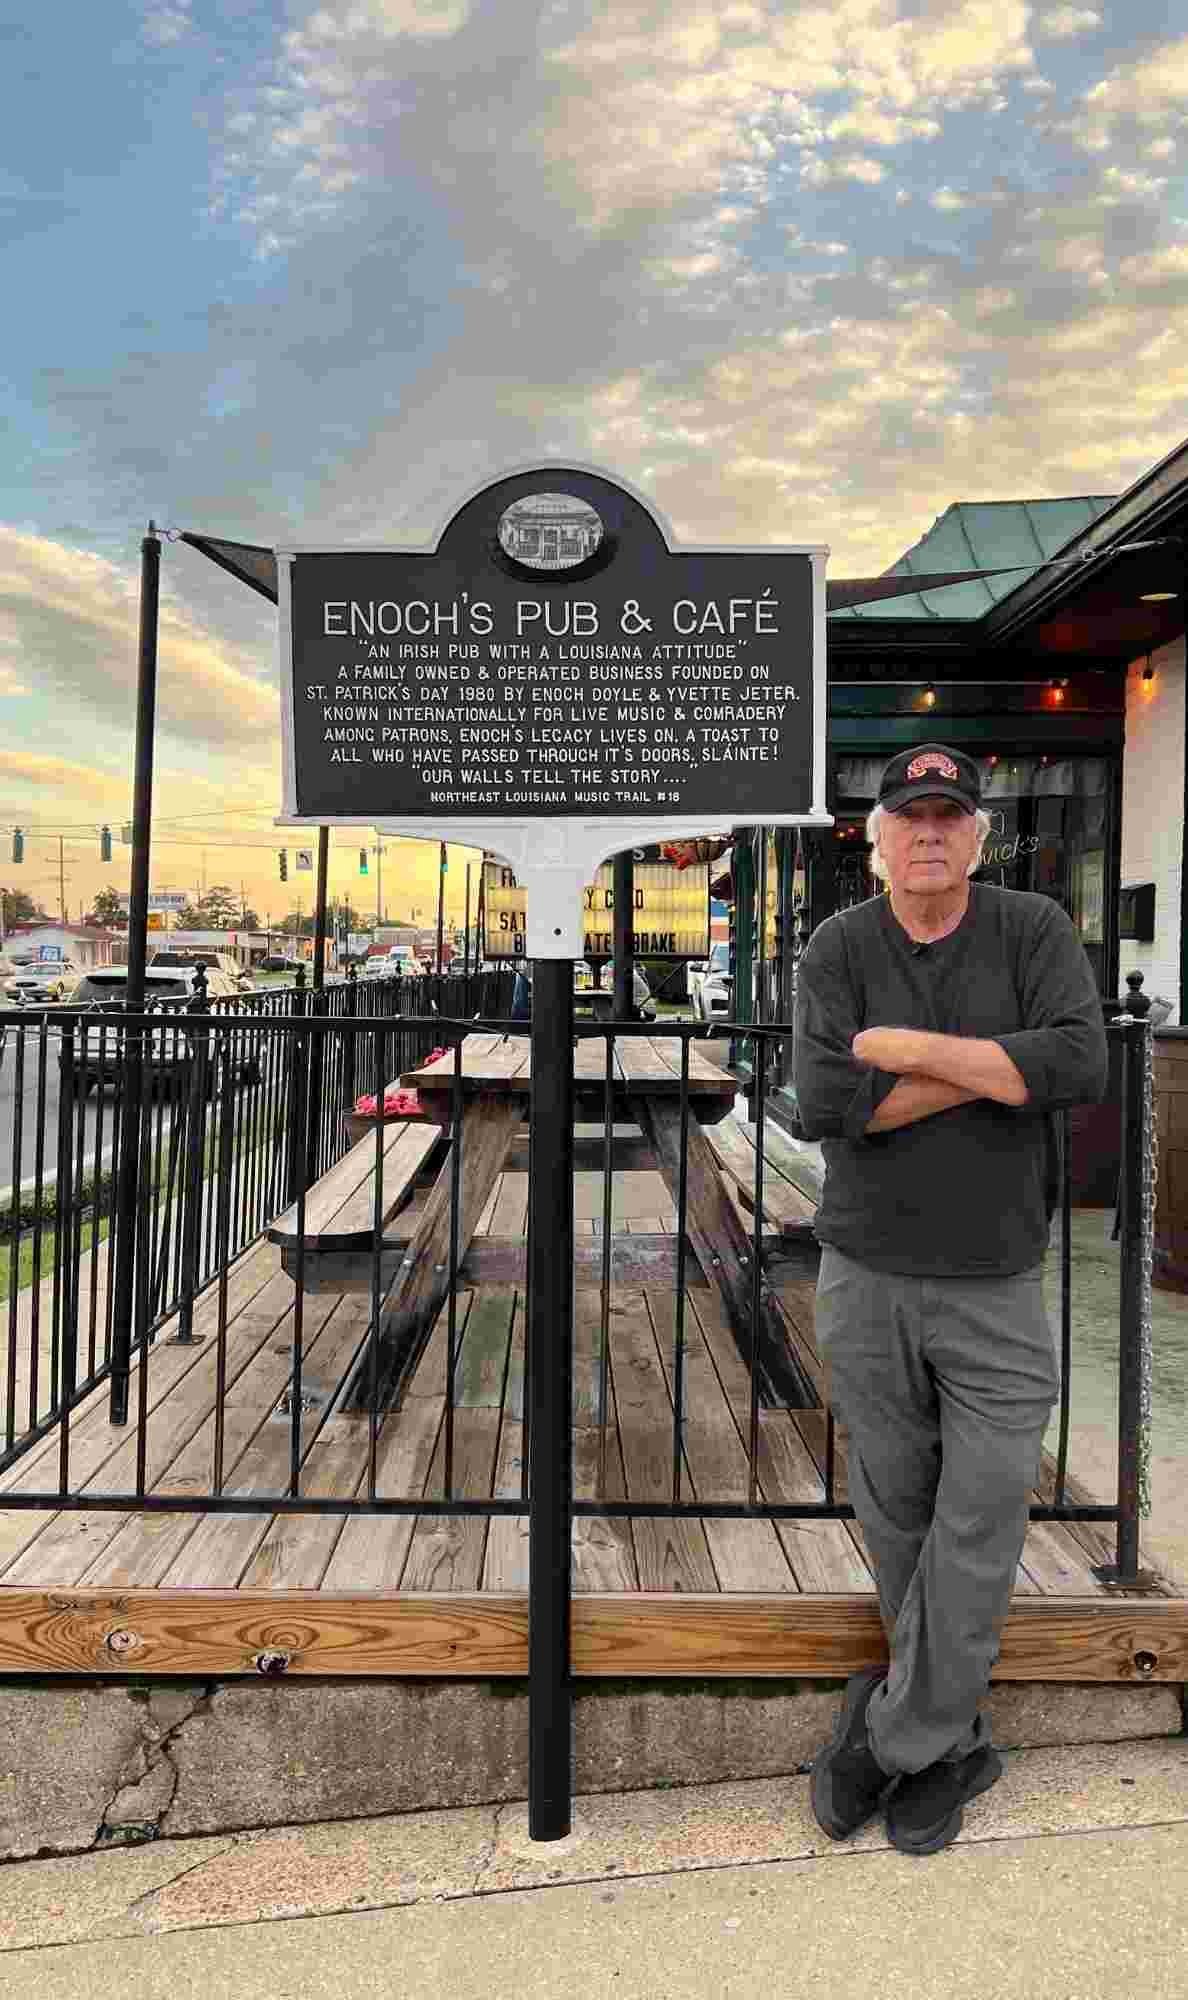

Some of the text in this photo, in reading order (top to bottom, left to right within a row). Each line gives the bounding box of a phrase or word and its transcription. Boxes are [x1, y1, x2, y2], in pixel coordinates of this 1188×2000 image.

[323, 587, 779, 636] ENOCH'S PUB & CAFÉ
[399, 644, 439, 659] IRISH
[448, 644, 480, 659] PUB
[489, 644, 531, 659] WITH
[539, 645, 550, 659] A
[559, 644, 643, 660] LOUISIANA
[337, 664, 769, 681] A FAMILY OWNED & OPERATED BUSINESS FOUNDED ON
[306, 682, 800, 702] ST. PATRICK'S DAY 1980 BY ENOCH DOYLE & YVETTE JETER.
[323, 705, 785, 722] KNOWN INTERNATIONALLY FOR LIVE MUSIC & COMRADERY
[323, 723, 779, 745] AMONG PATRONS, ENOCH'S LEGACY LIVES ON. A TOAST TO
[330, 748, 362, 763] ALL
[372, 748, 404, 763] WHO
[412, 748, 453, 763] HAVE
[461, 748, 519, 763] PASSED
[526, 748, 598, 763] THROUGH
[605, 745, 634, 763] IT'S
[460, 769, 514, 784] WALLS
[520, 769, 565, 784] TELL
[570, 769, 603, 784] THE
[430, 791, 501, 803] NORTHEAST
[505, 791, 567, 803] LOUISIANA
[574, 791, 610, 802] MUSIC
[614, 791, 651, 802] TRAIL
